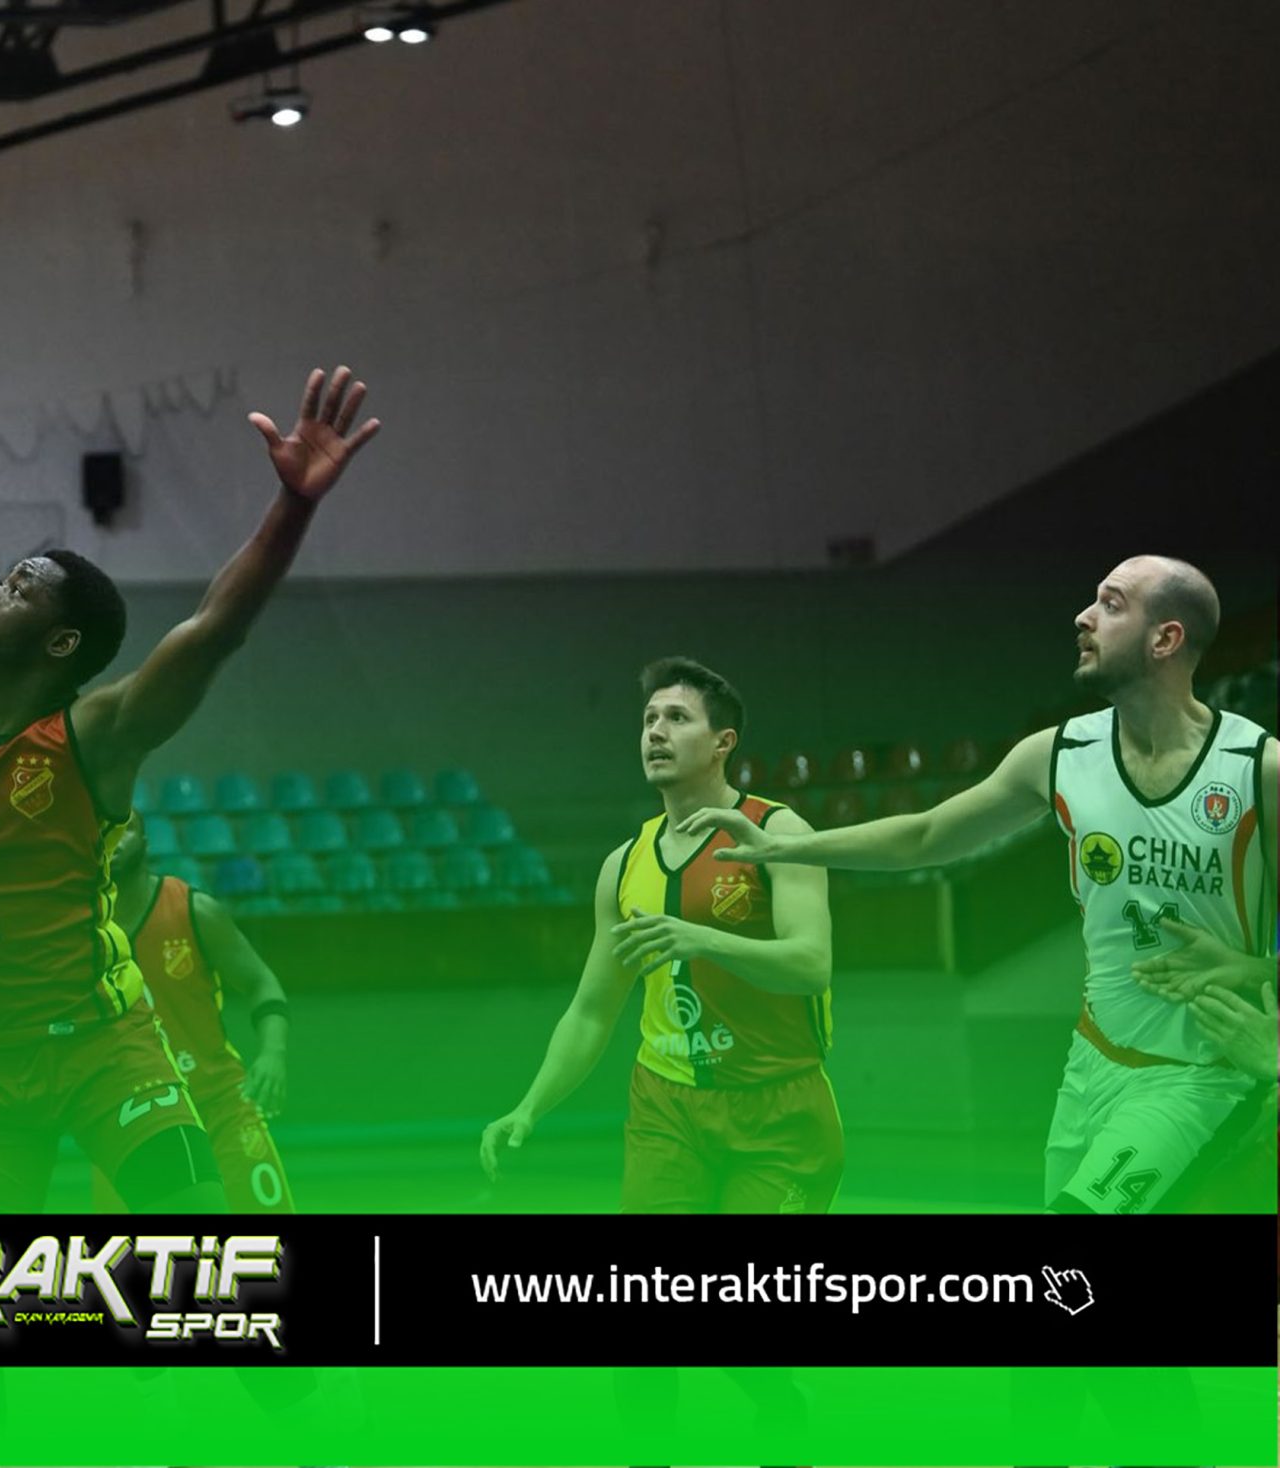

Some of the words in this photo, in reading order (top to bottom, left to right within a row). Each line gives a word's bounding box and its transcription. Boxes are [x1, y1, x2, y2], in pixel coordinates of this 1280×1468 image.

[1128, 835, 1223, 874] CHINA
[1128, 864, 1224, 897] BAZAAR
[251, 1162, 283, 1207] 0
[1087, 1145, 1162, 1214] 14
